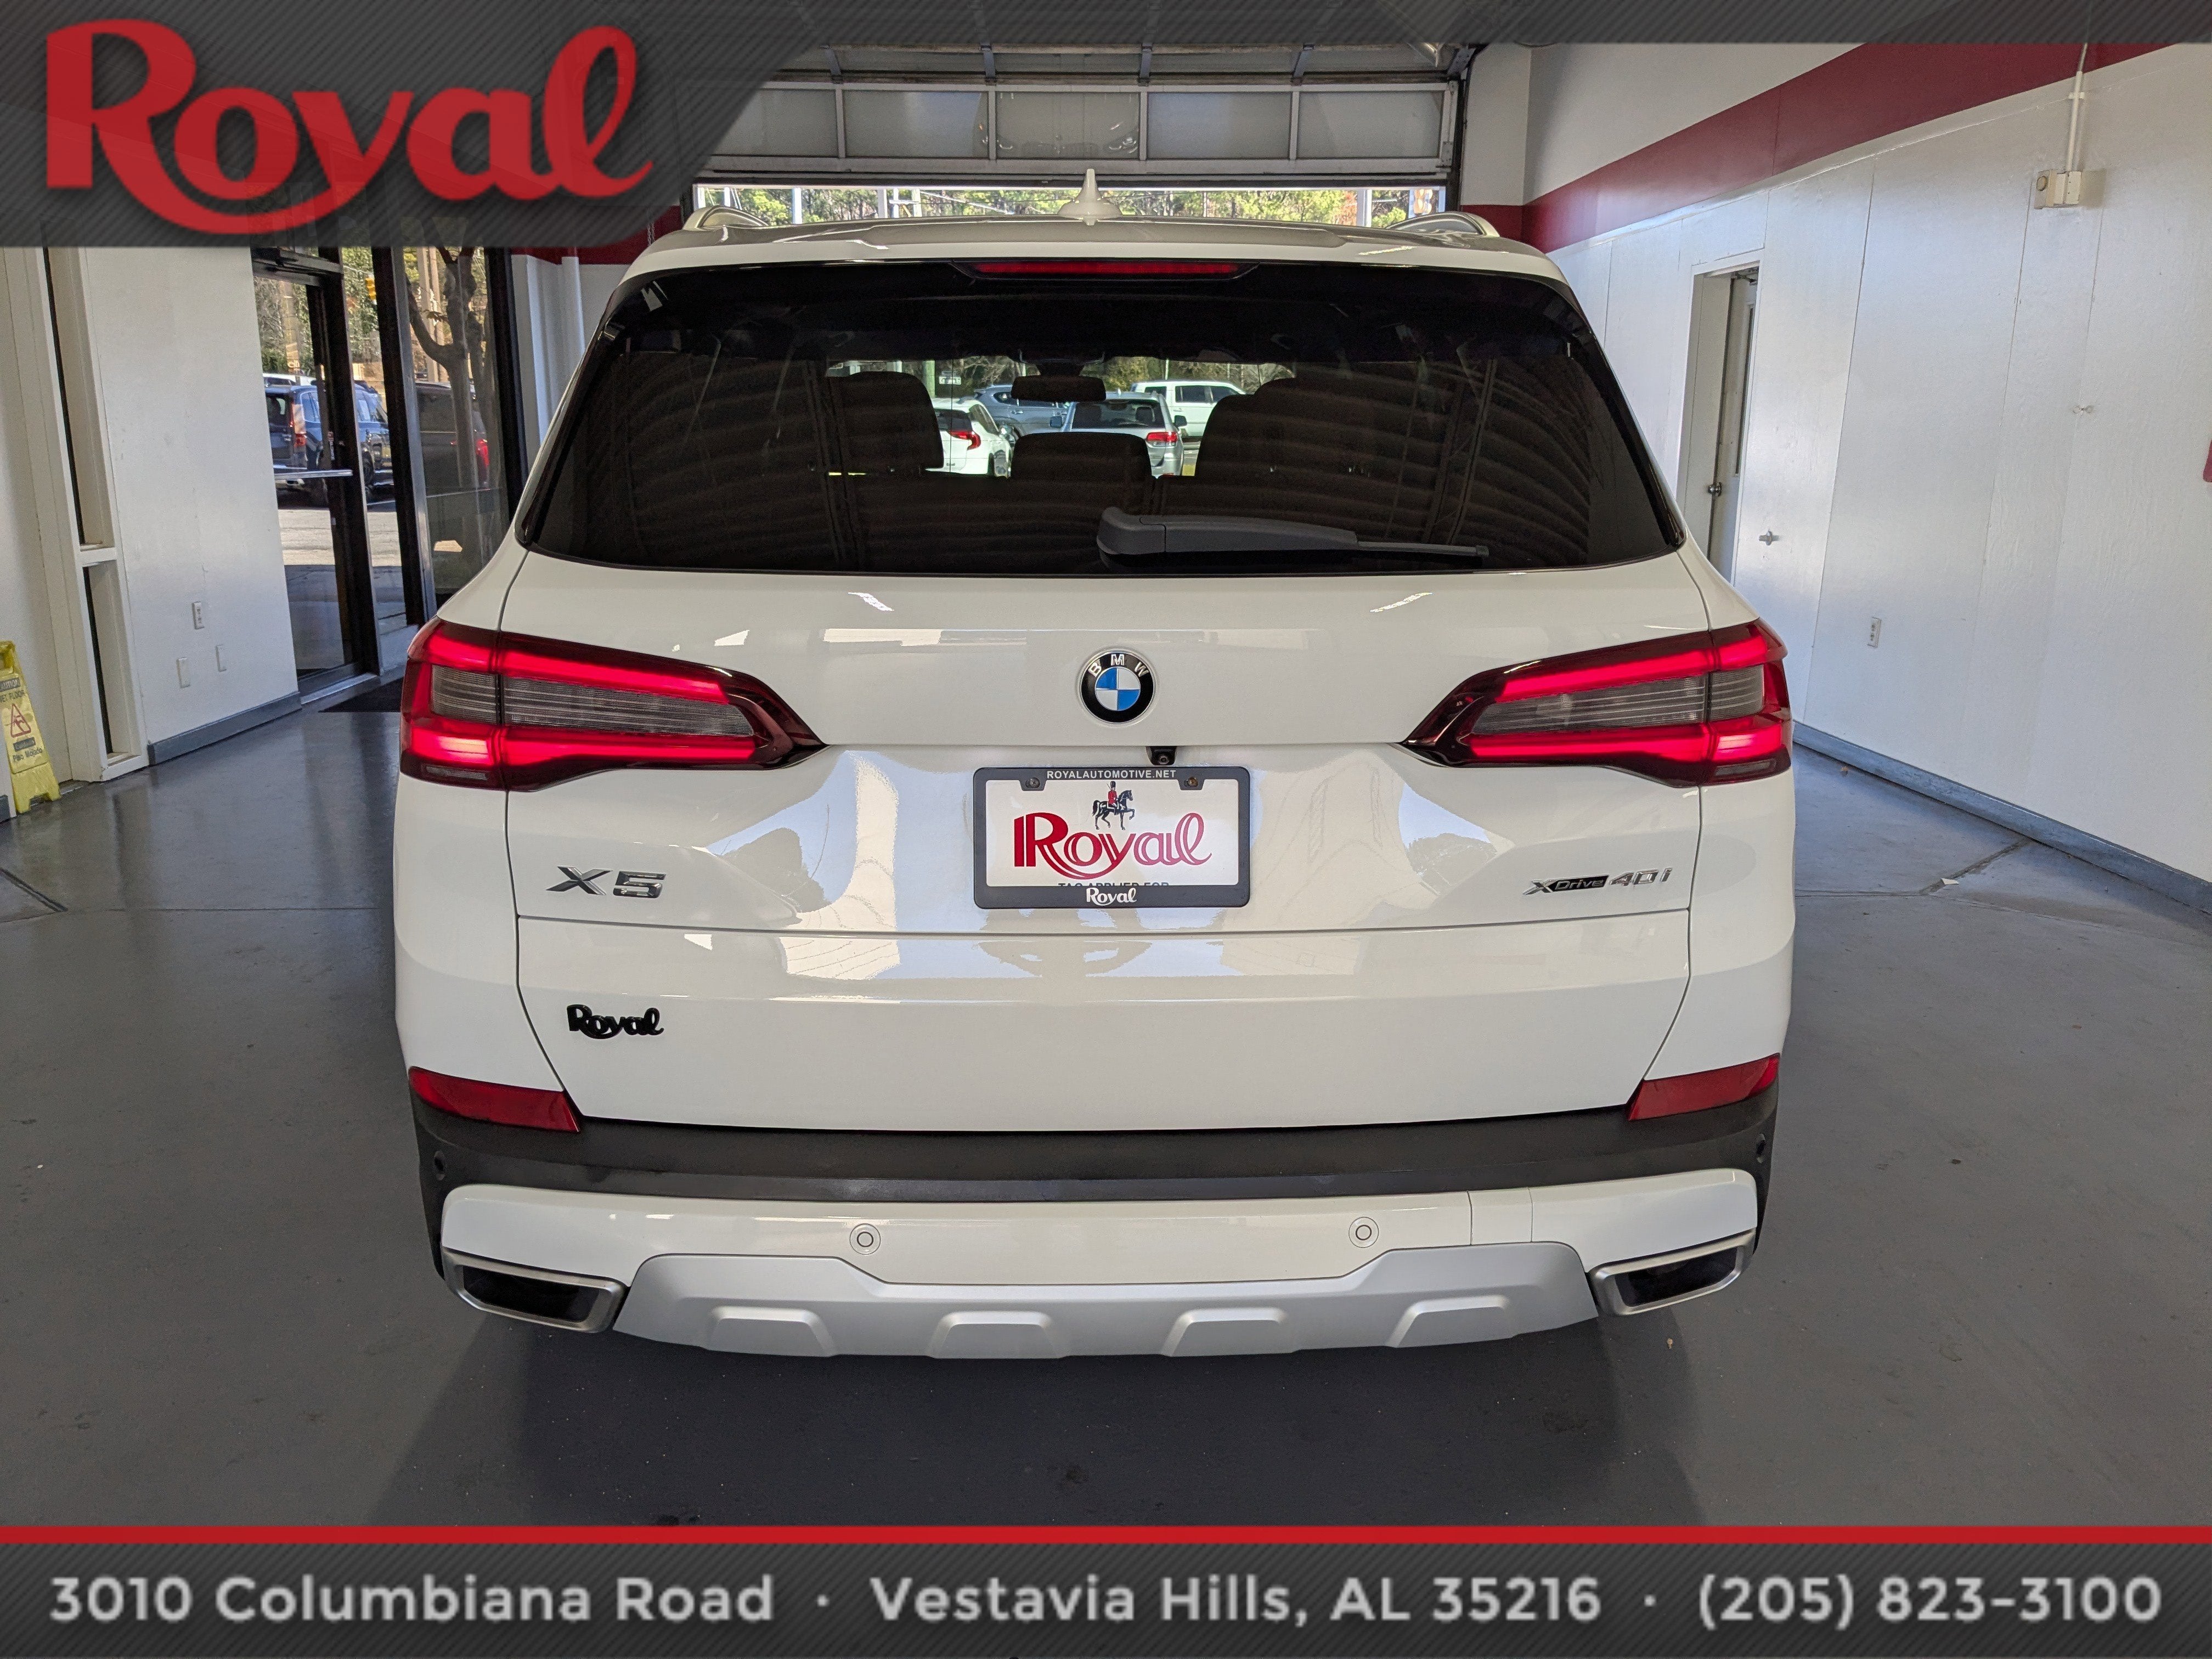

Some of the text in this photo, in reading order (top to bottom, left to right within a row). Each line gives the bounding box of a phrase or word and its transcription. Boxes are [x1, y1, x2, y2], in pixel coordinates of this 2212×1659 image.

[1088, 653, 1149, 678] BMW
[0, 679, 19, 691] AUTION
[1047, 770, 1176, 779] ROYALAUTOMOTIVE.NET
[1014, 812, 1212, 880] Royal
[546, 866, 667, 898] X5
[1086, 887, 1137, 906] Royal
[567, 1004, 664, 1040] Royal
